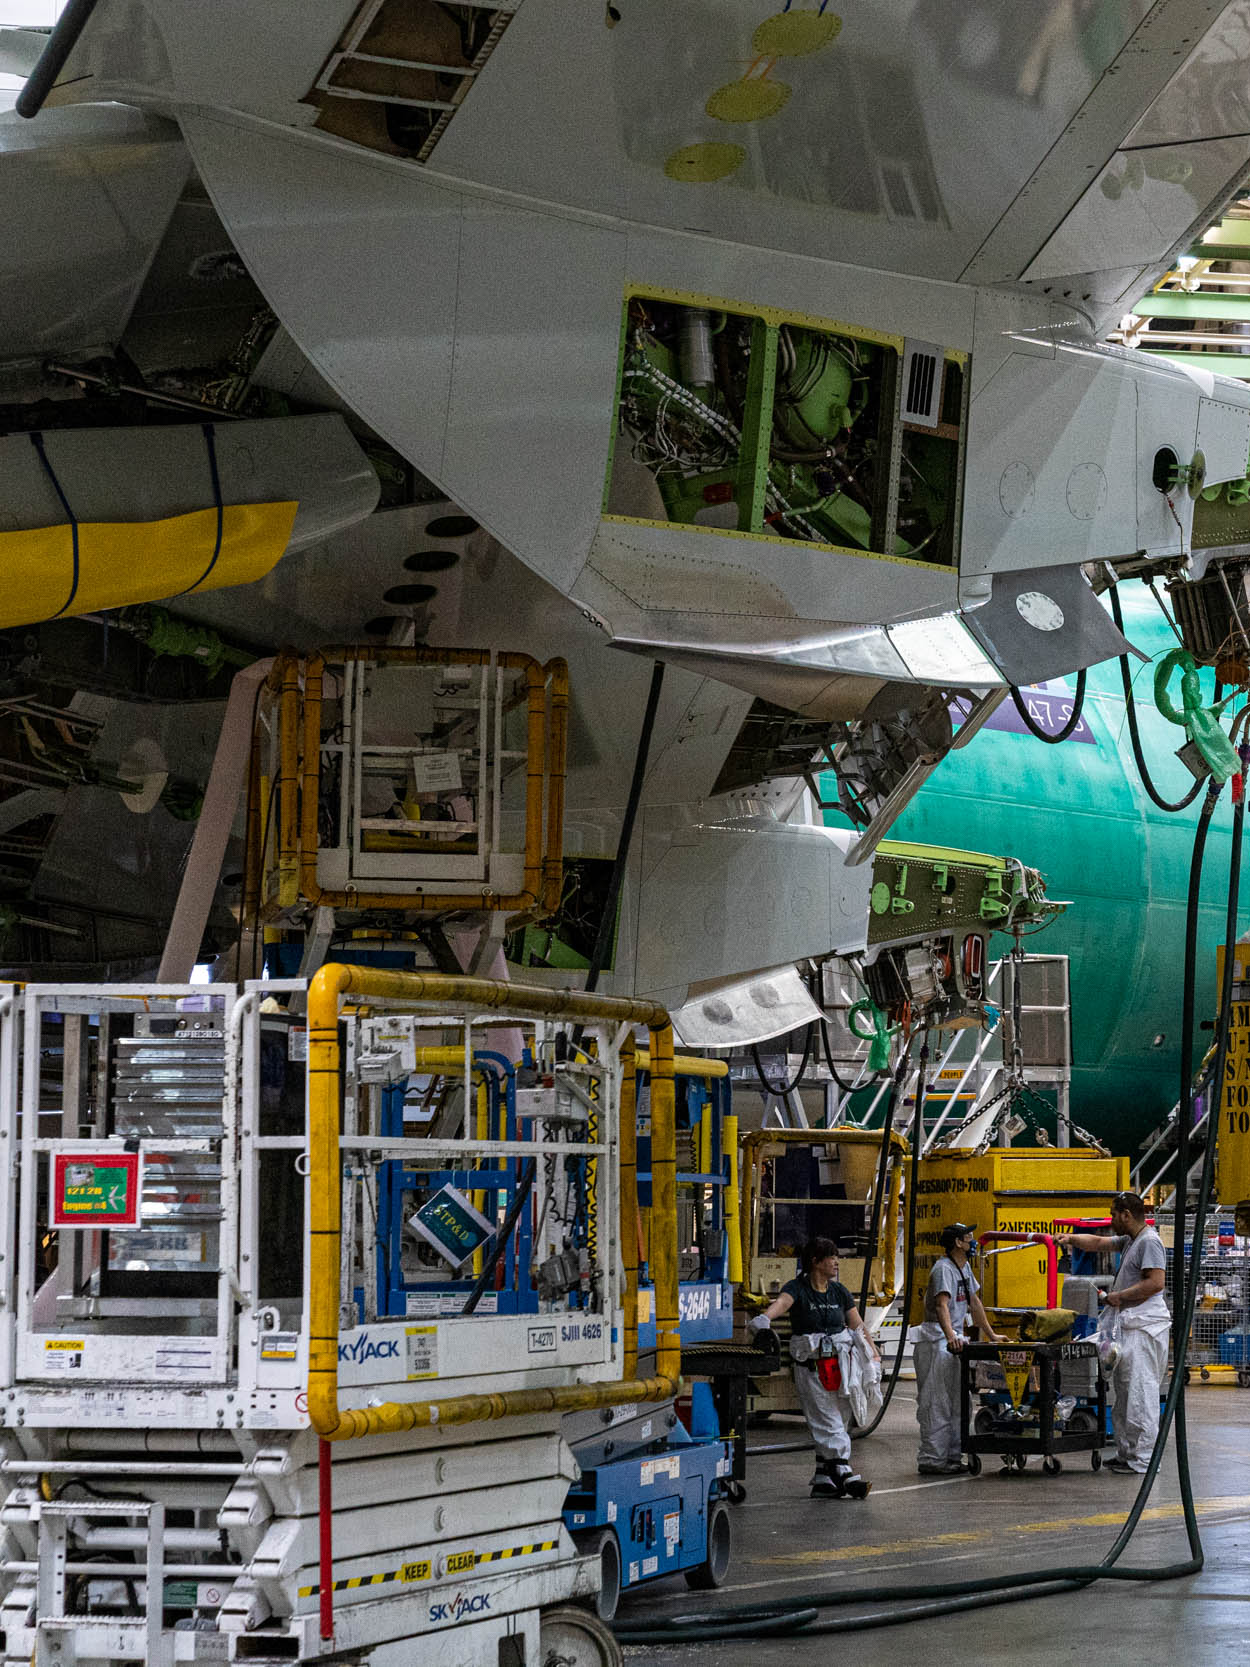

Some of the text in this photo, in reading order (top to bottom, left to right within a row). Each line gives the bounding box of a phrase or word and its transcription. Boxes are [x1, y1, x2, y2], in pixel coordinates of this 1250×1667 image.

[679, 1291, 710, 1322] S-2646
[338, 1332, 400, 1365] KYJACK
[404, 1554, 474, 1580] KEEP CLEAR
